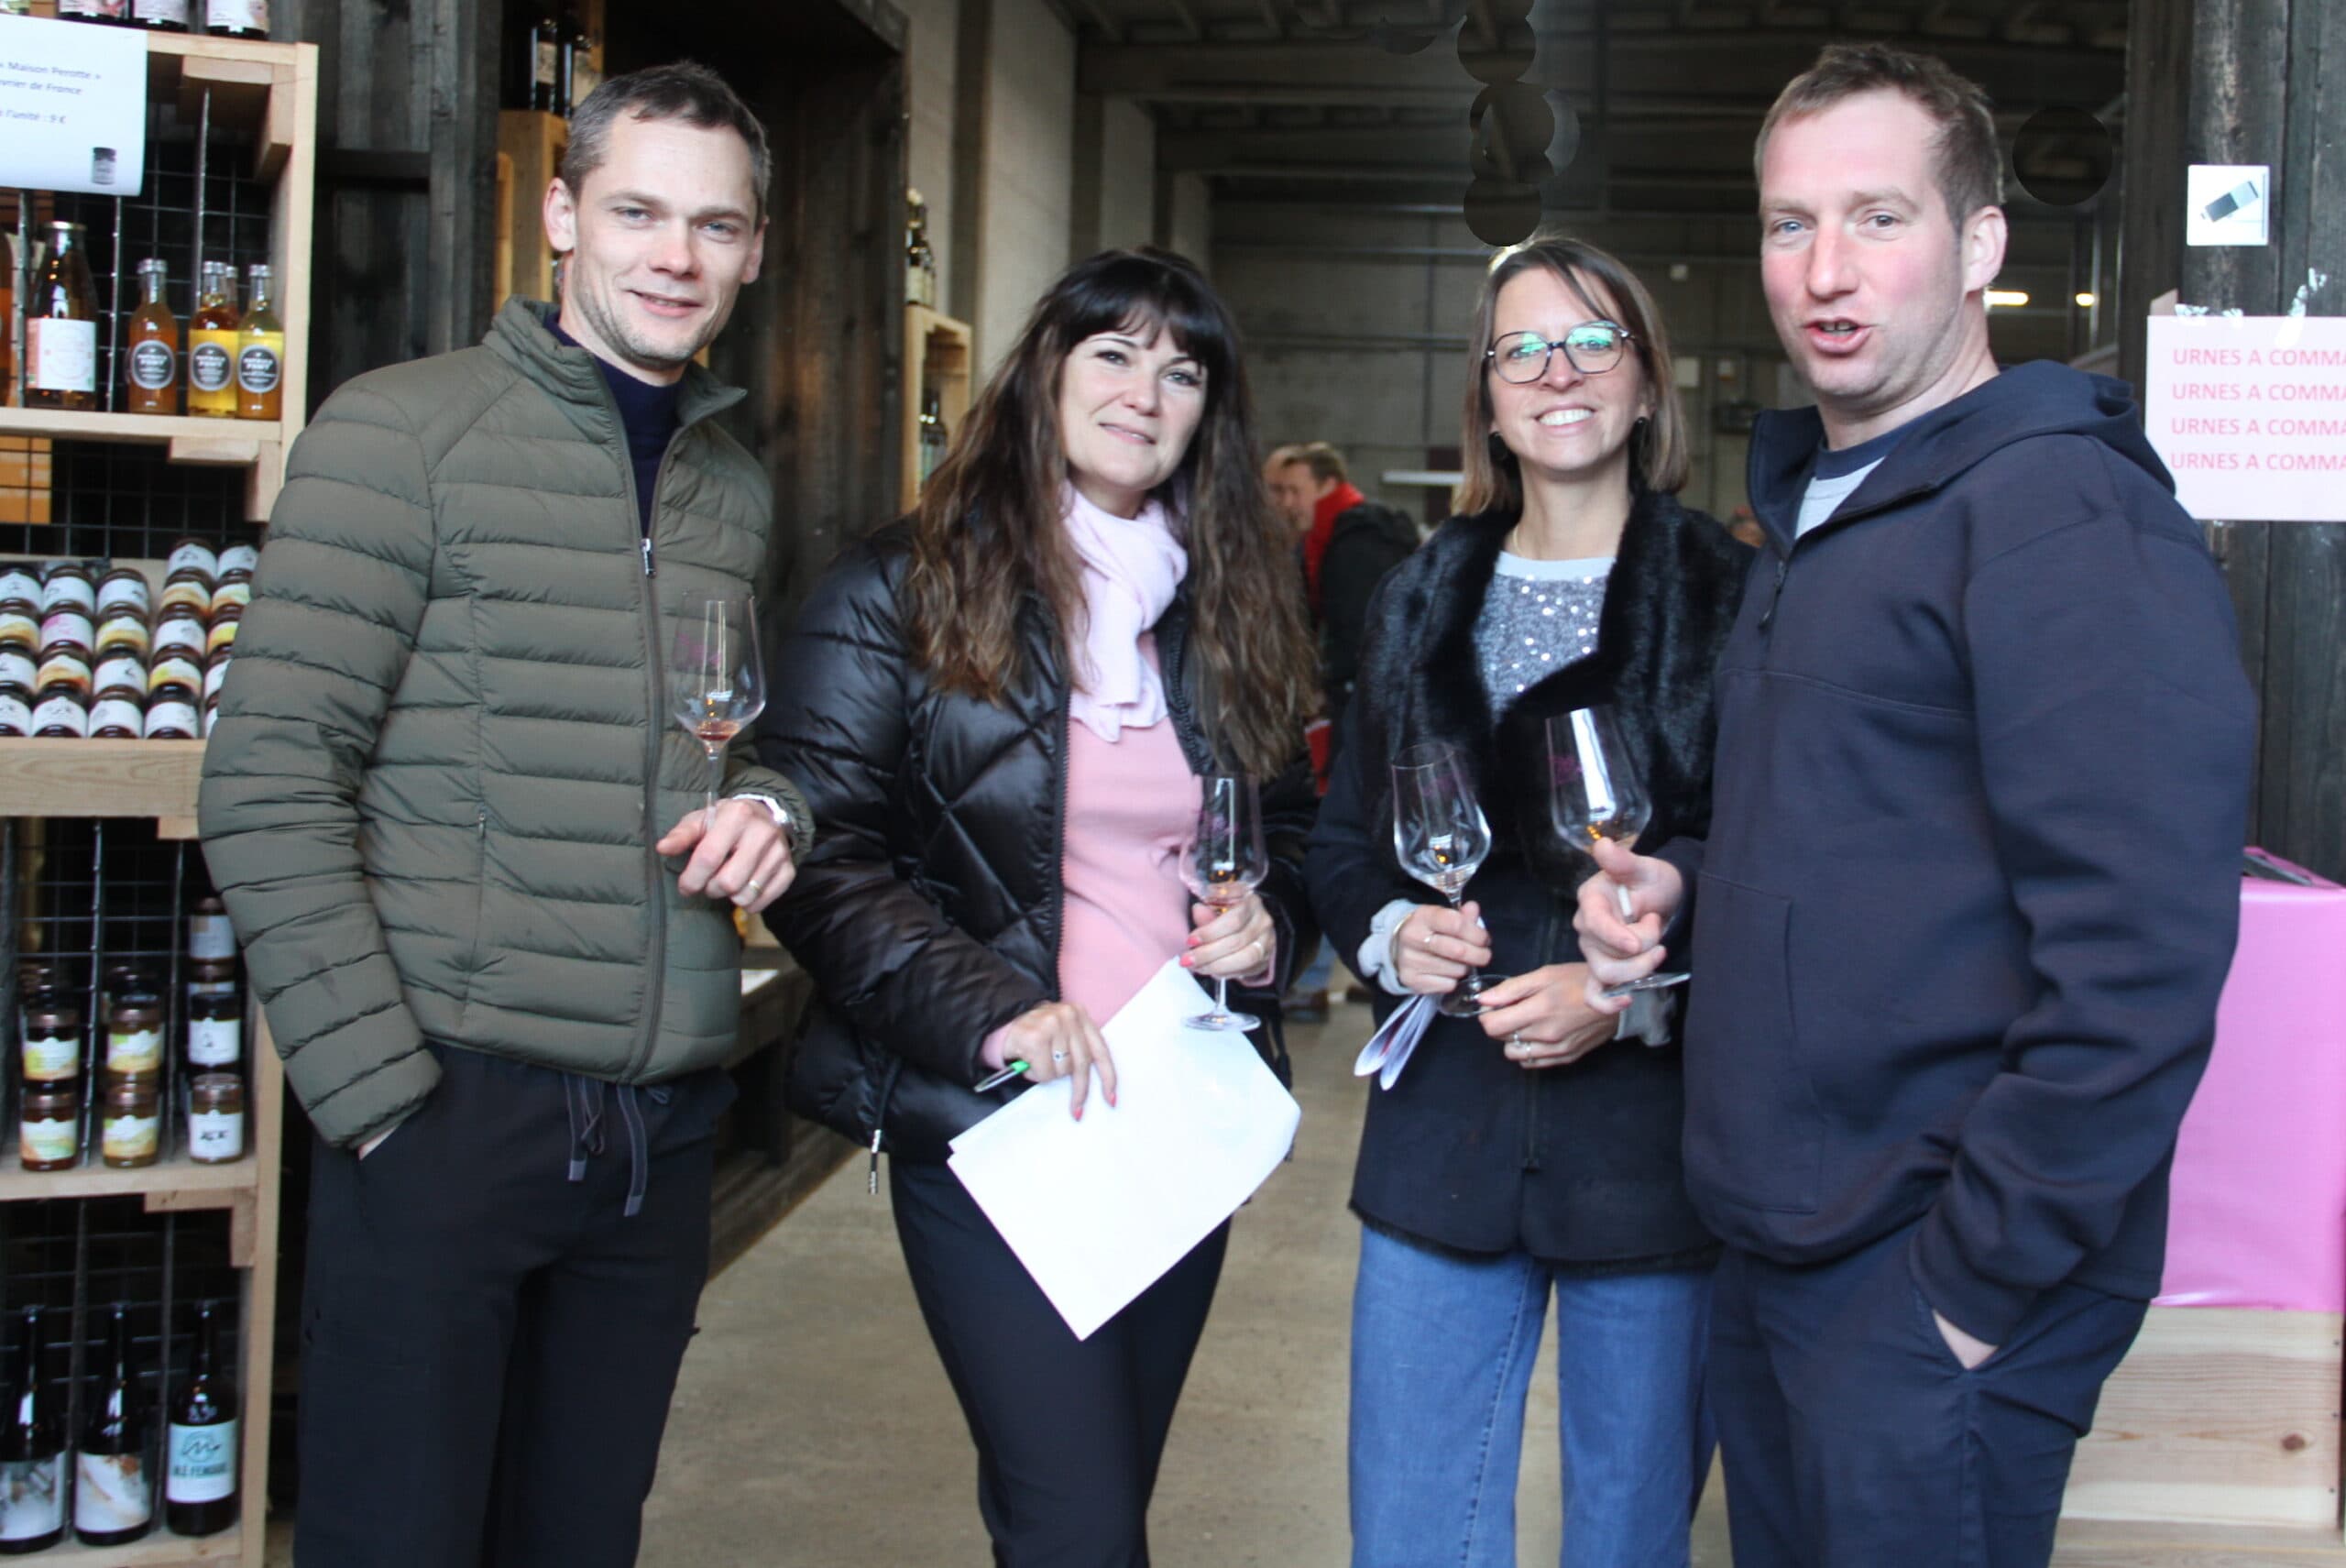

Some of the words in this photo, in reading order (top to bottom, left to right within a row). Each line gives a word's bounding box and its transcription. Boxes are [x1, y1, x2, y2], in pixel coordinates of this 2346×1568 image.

[8, 61, 49, 73] Maison
[46, 83, 82, 94] France
[2173, 348, 2242, 366] URNES
[2248, 349, 2262, 366] A
[2172, 383, 2241, 400] URNES
[2247, 384, 2261, 400] A
[2171, 418, 2240, 435] URNES
[2247, 419, 2260, 435] A
[2170, 453, 2239, 469] URNES
[2246, 454, 2259, 470] A
